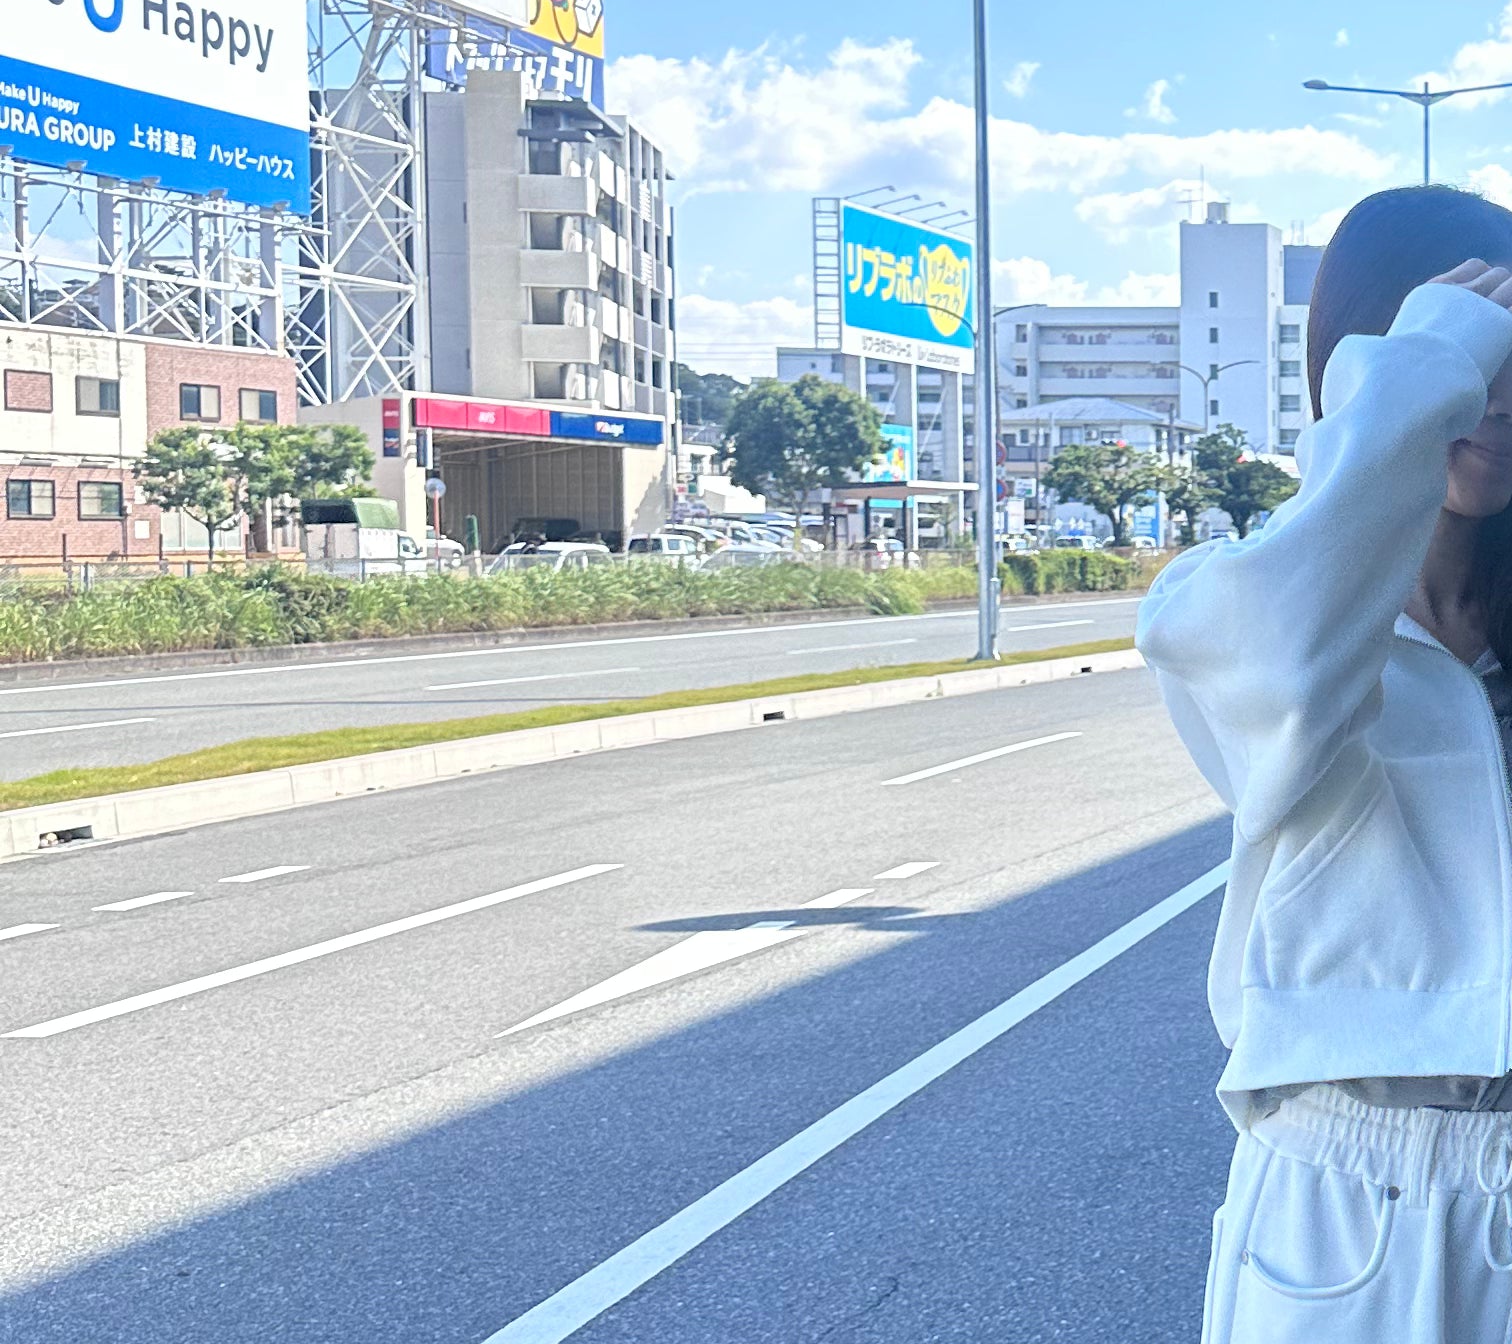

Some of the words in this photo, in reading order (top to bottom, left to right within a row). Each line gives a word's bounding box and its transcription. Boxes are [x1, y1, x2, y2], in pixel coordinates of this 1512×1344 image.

[27, 85, 41, 107] U
[42, 91, 80, 115] Happy
[43, 115, 116, 152] GROUP
[128, 123, 197, 160] 上村建設
[208, 144, 296, 180] ハッピーハウス
